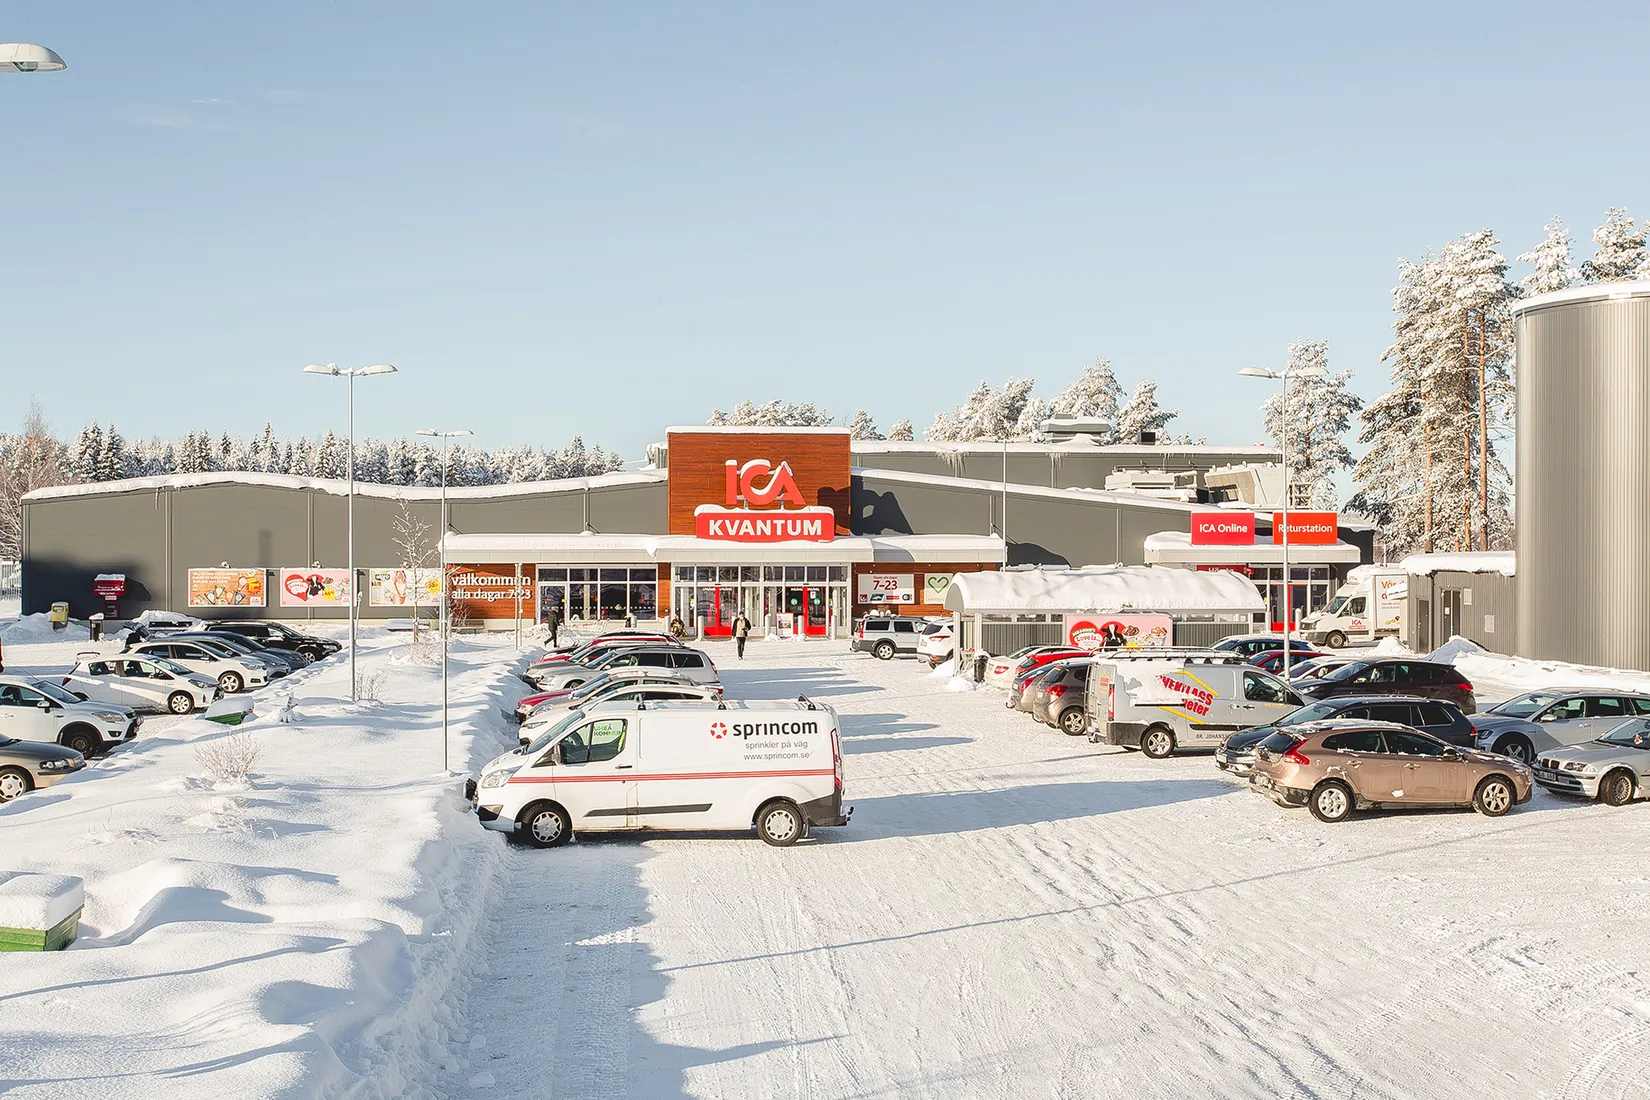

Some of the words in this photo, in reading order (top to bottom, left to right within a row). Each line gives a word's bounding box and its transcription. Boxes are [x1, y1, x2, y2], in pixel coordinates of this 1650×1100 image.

[725, 461, 807, 505] ICA
[708, 519, 822, 536] KVANTUM
[1199, 523, 1217, 533] ICA
[1218, 523, 1248, 533] Online
[451, 589, 472, 599] alla
[474, 589, 506, 602] dagar
[732, 721, 818, 740] sprincom
[745, 741, 779, 750] sprinkler
[781, 740, 792, 749] på
[793, 740, 808, 749] väg
[743, 751, 810, 761] www.sprincom.se
